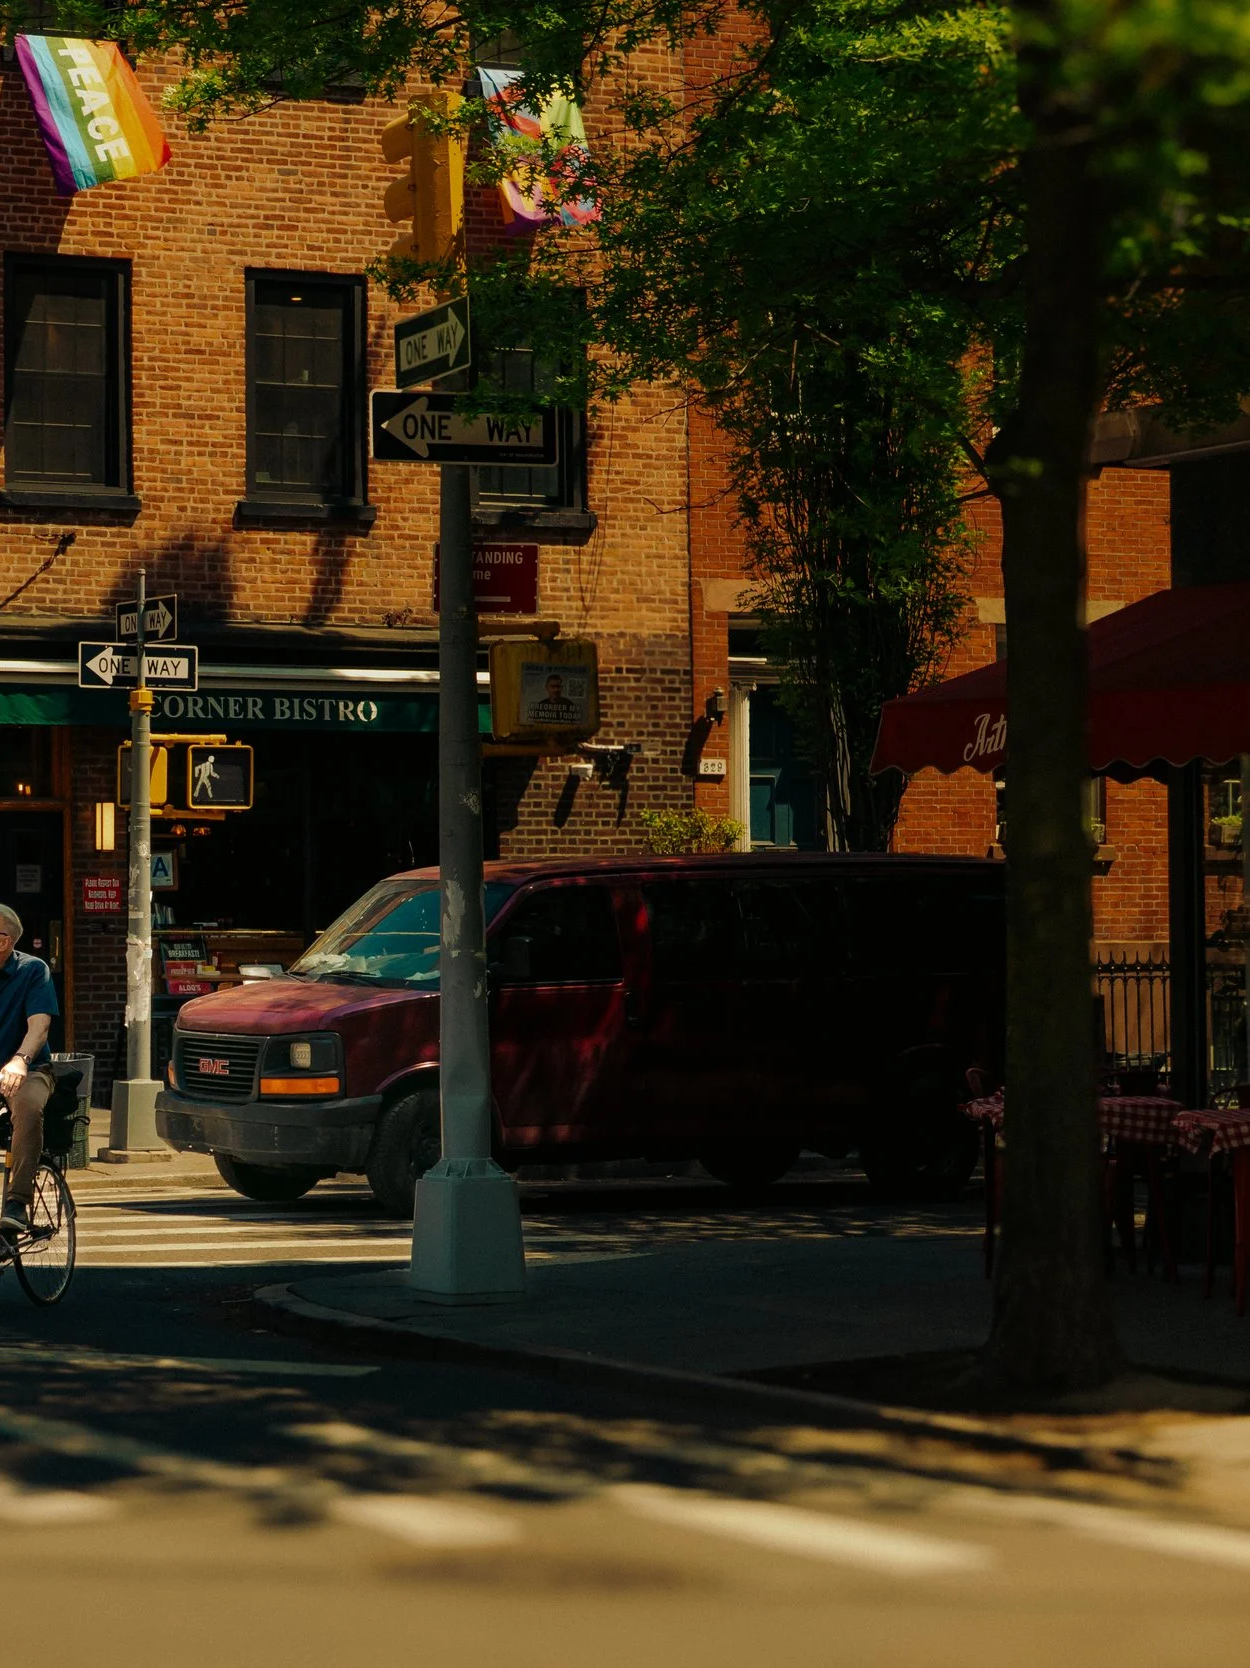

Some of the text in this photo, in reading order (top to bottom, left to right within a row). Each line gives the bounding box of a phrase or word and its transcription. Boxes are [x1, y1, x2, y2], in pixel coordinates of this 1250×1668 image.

[58, 48, 130, 162] PEACE
[406, 323, 458, 365] ONE WAY
[403, 414, 534, 443] ONE WAY
[125, 611, 167, 632] ON WAY
[98, 657, 182, 676] ONE WAY
[151, 695, 378, 722] CORNER BISTRO
[152, 856, 169, 878] A
[199, 1058, 230, 1075] GMC
